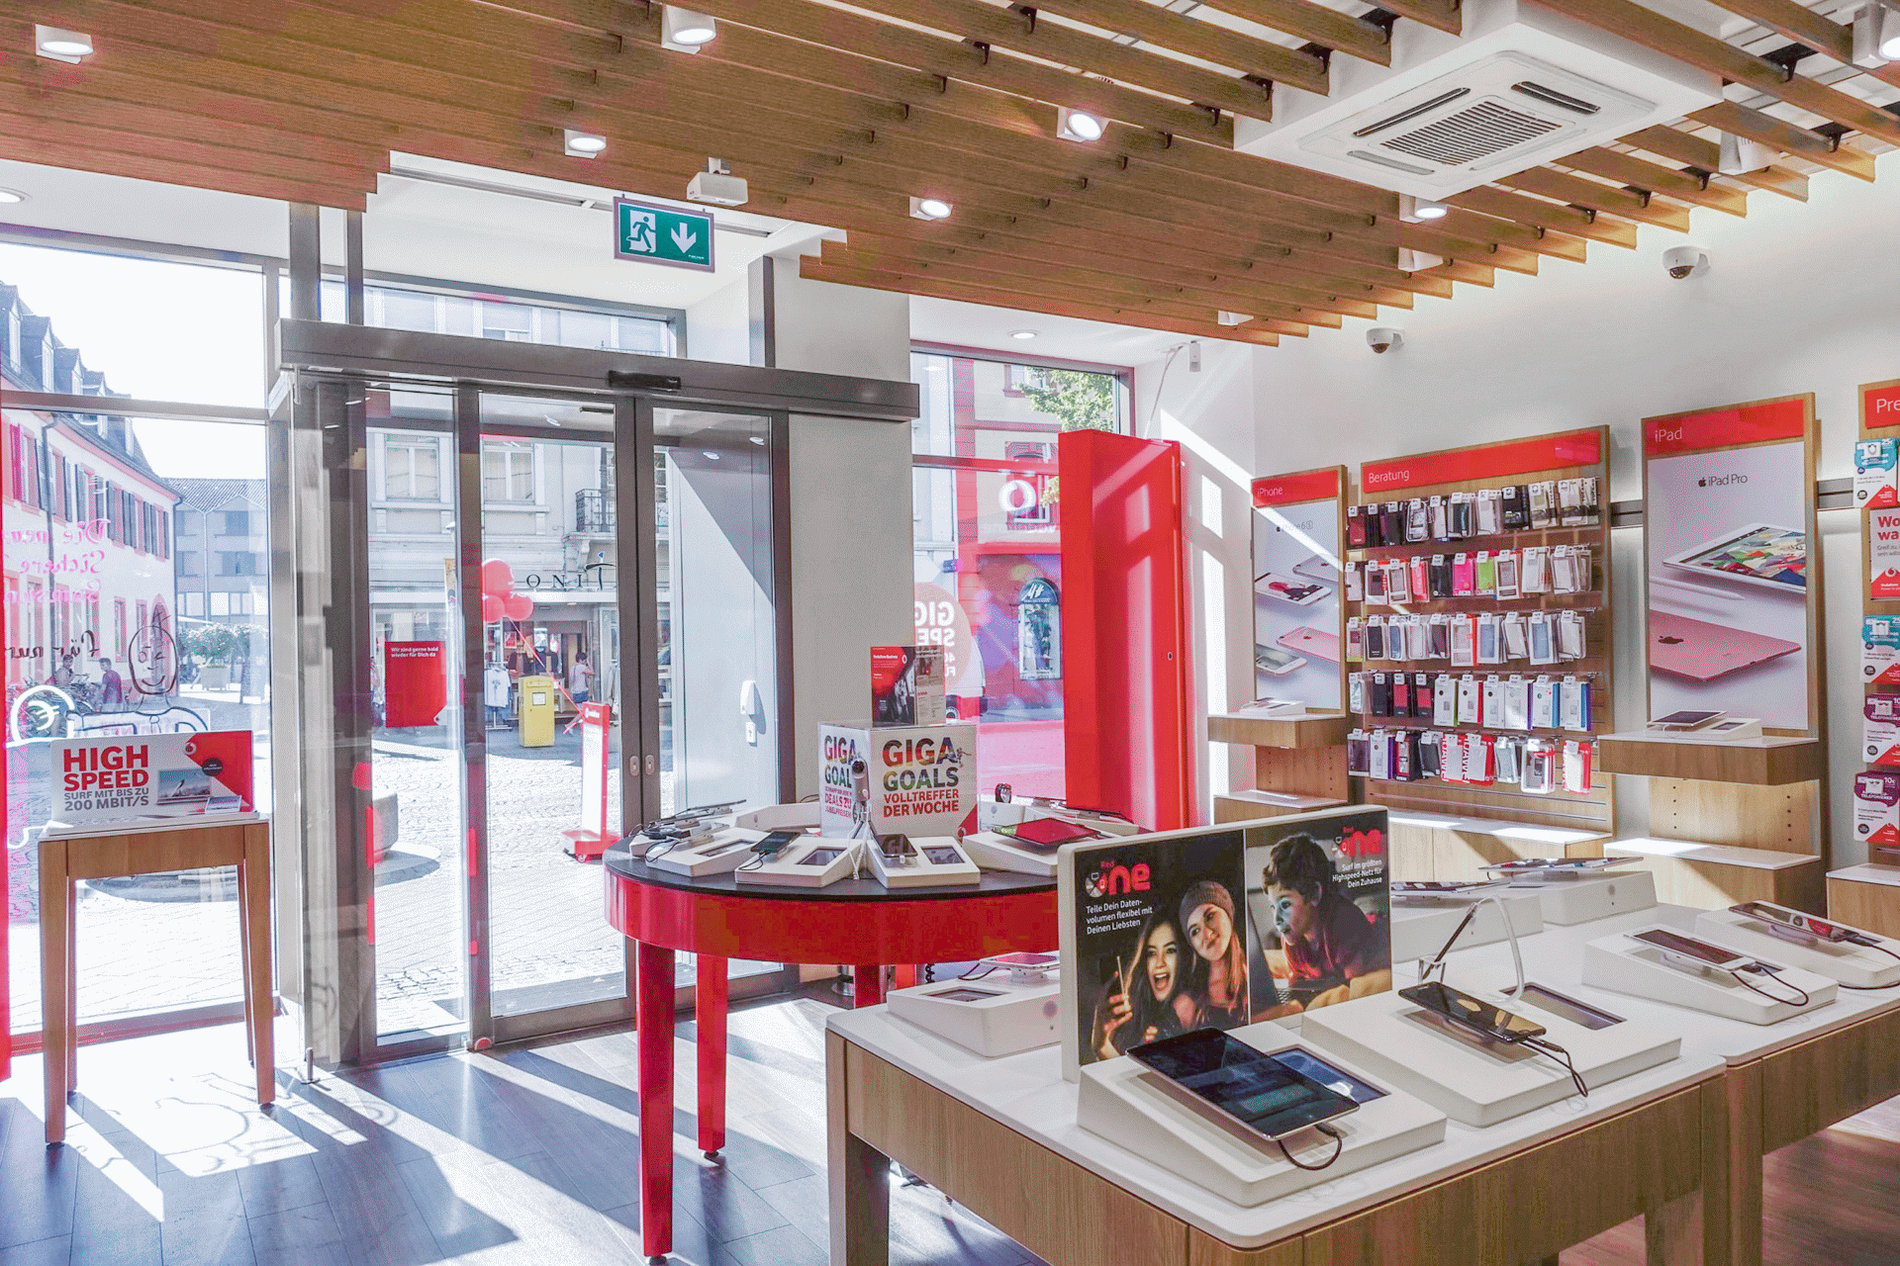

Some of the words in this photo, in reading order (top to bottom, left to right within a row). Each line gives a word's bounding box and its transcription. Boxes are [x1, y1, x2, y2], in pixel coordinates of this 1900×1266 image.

[1654, 426, 1682, 442] iPad
[1368, 469, 1410, 484] Beratung
[1708, 474, 1729, 486] iPad
[1731, 473, 1748, 484] Pro
[1257, 486, 1283, 497] iPhone
[63, 744, 149, 772] HIGH
[824, 735, 856, 765] GIGA
[882, 737, 958, 768] GIGA
[64, 769, 149, 792] SPEED
[882, 767, 959, 792] GOALS
[64, 791, 93, 801] SURF
[94, 790, 114, 798] MIT
[116, 789, 133, 797] BIS
[135, 787, 149, 796] ZU
[884, 789, 959, 804] VOLLTREFFER
[65, 800, 93, 811] 200
[96, 795, 149, 809] MBIT/S
[883, 803, 910, 817] DER
[913, 800, 959, 814] WOCHE
[1342, 862, 1353, 871] Surf
[1362, 859, 1382, 869] größten
[1332, 869, 1374, 882] Highspeed-Netz
[1361, 877, 1382, 886] Zuhause
[1086, 905, 1103, 914] Teile
[1103, 902, 1120, 912] Dein
[1120, 899, 1142, 909] Daten-
[1086, 914, 1116, 924] volumen
[1116, 908, 1141, 919] flexibel
[1141, 906, 1153, 915] mit
[1086, 924, 1111, 935] Deinen
[1112, 919, 1141, 930] Liebsten
